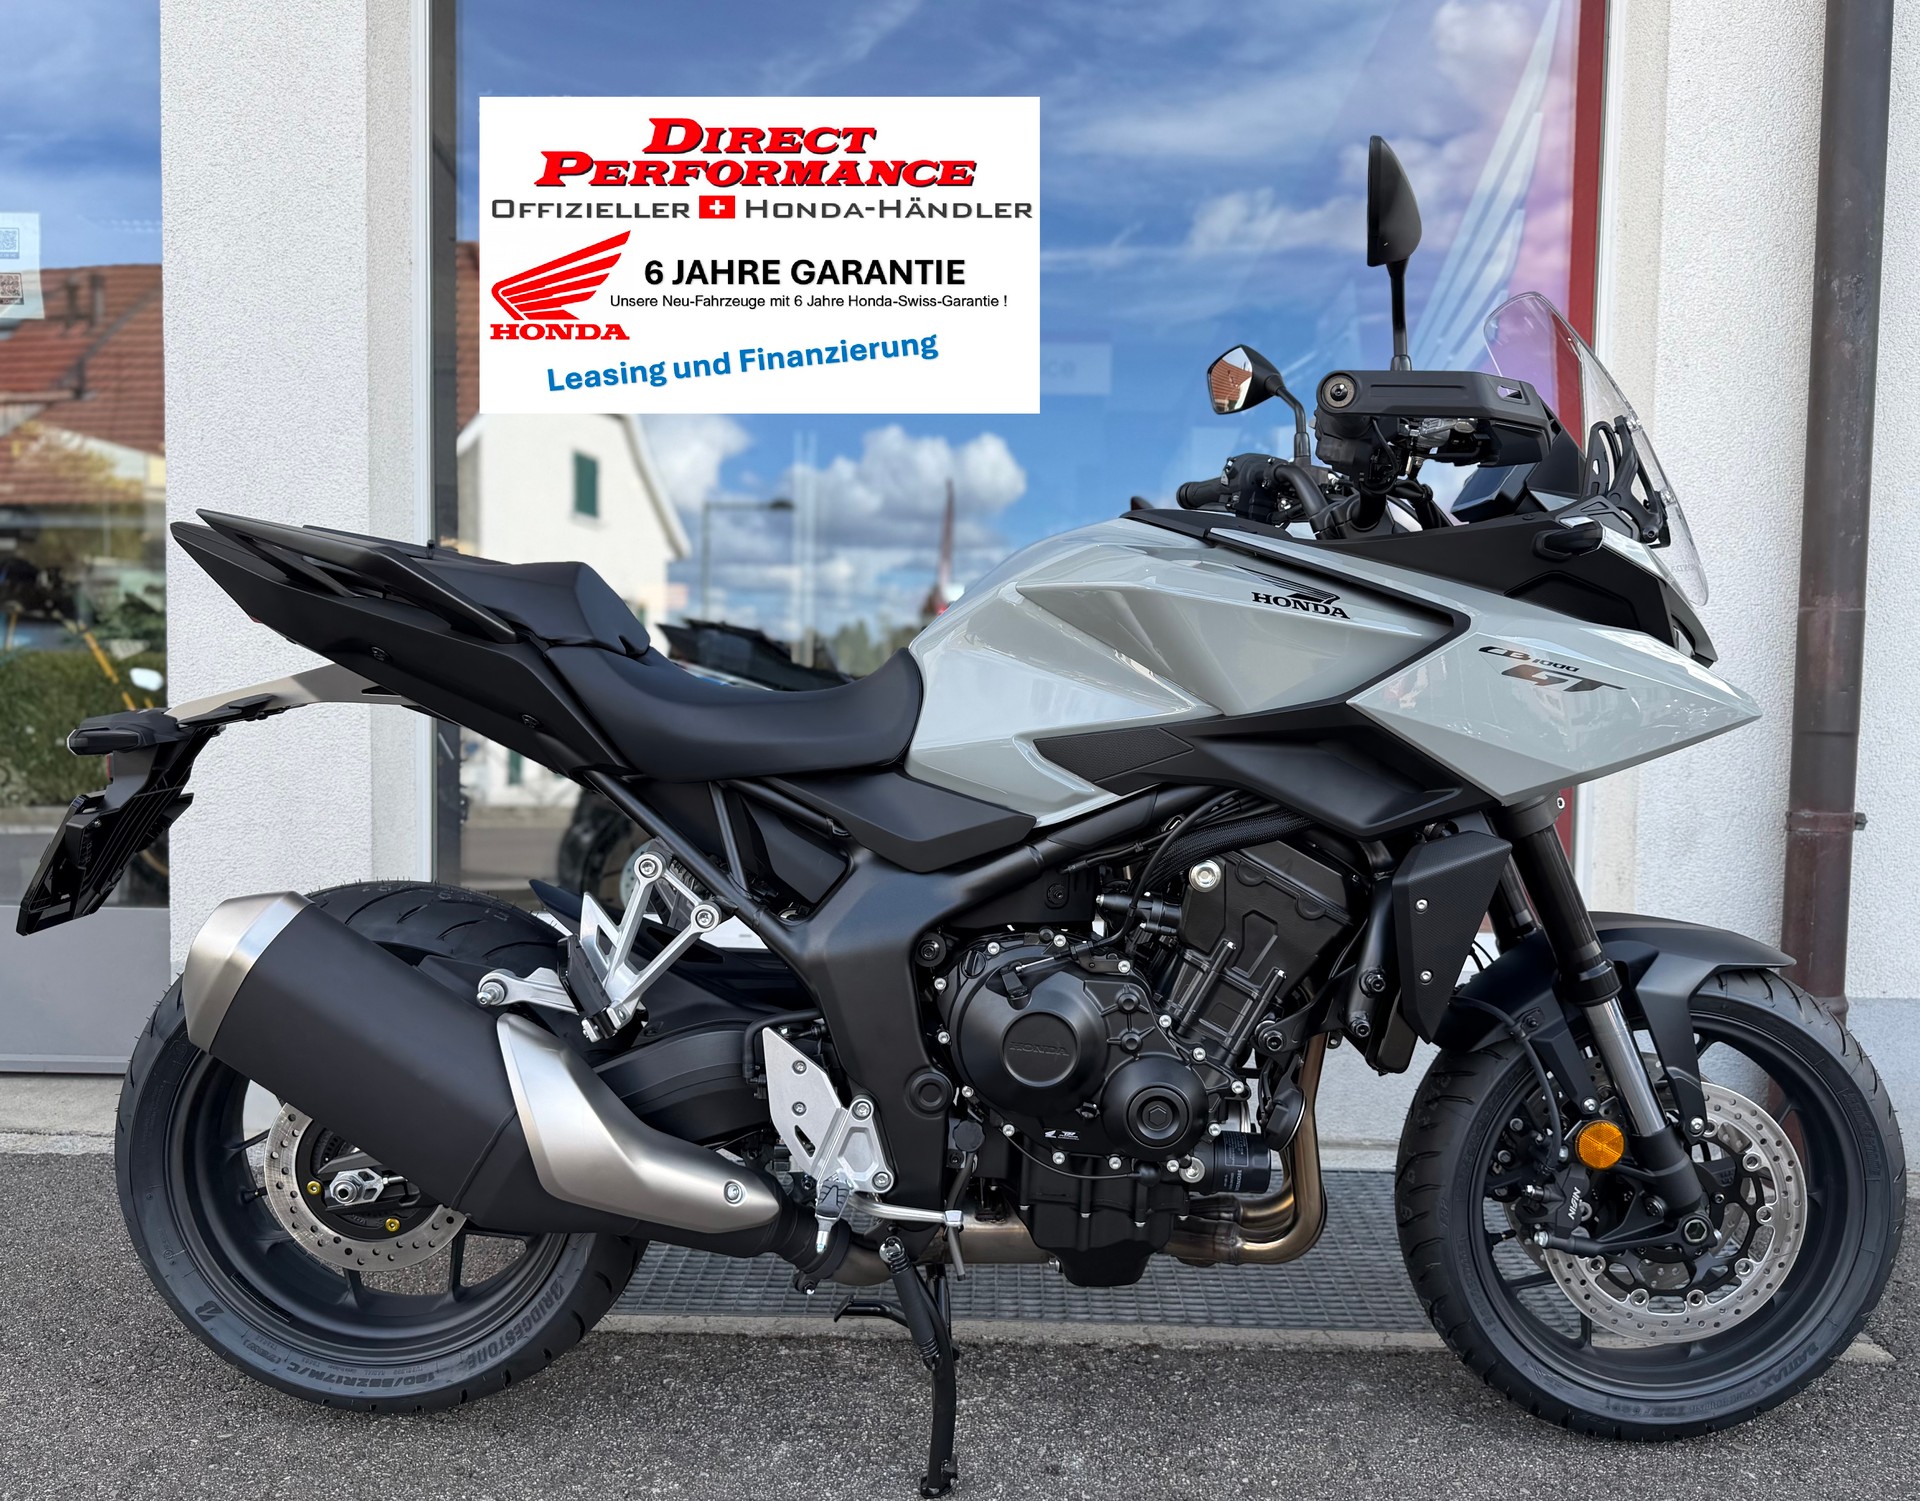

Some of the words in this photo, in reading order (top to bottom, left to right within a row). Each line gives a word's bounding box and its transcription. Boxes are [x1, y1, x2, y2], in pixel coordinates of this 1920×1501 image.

[1251, 591, 1351, 620] HONDA
[1008, 1040, 1070, 1057] HONDA
[466, 1279, 565, 1371] BRIDGESTONE
